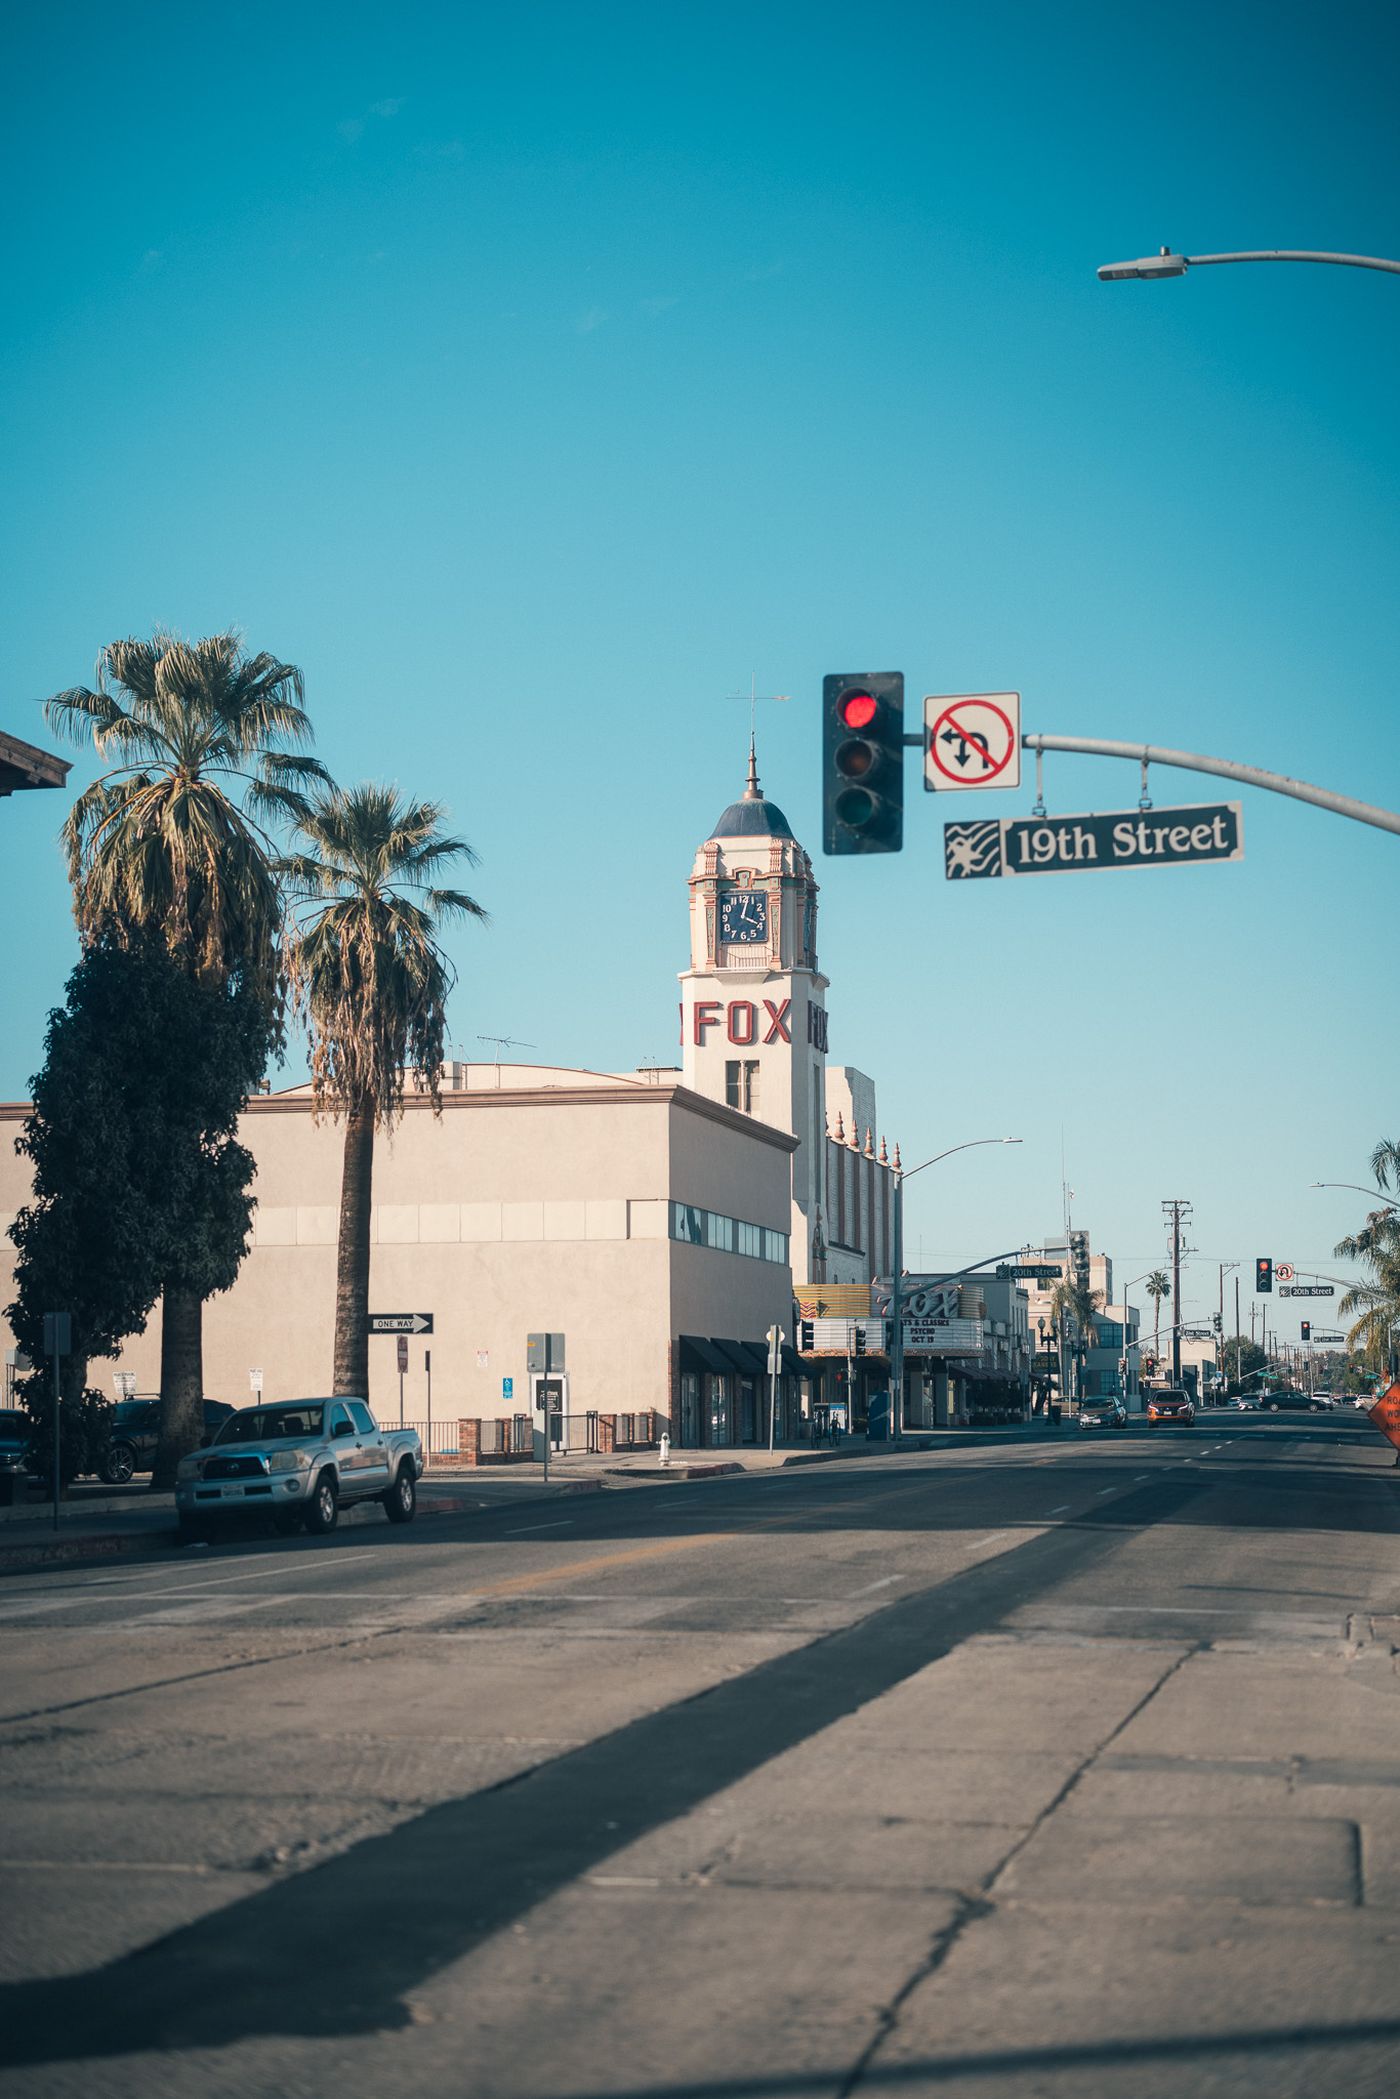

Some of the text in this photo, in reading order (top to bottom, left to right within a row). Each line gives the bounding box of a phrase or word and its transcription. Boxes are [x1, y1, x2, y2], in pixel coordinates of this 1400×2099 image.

[1018, 815, 1229, 864] 19th Street
[723, 904, 731, 912] 10
[756, 903, 762, 912] 2
[722, 914, 728, 922] 9
[760, 912, 766, 921] 3
[724, 924, 730, 932] 8
[731, 930, 737, 938] 7
[740, 932, 746, 940] 6
[750, 930, 757, 938] 5
[694, 998, 792, 1046] FOX
[1012, 1266, 1060, 1276] 20th Street
[1387, 1396, 1400, 1404] RO
